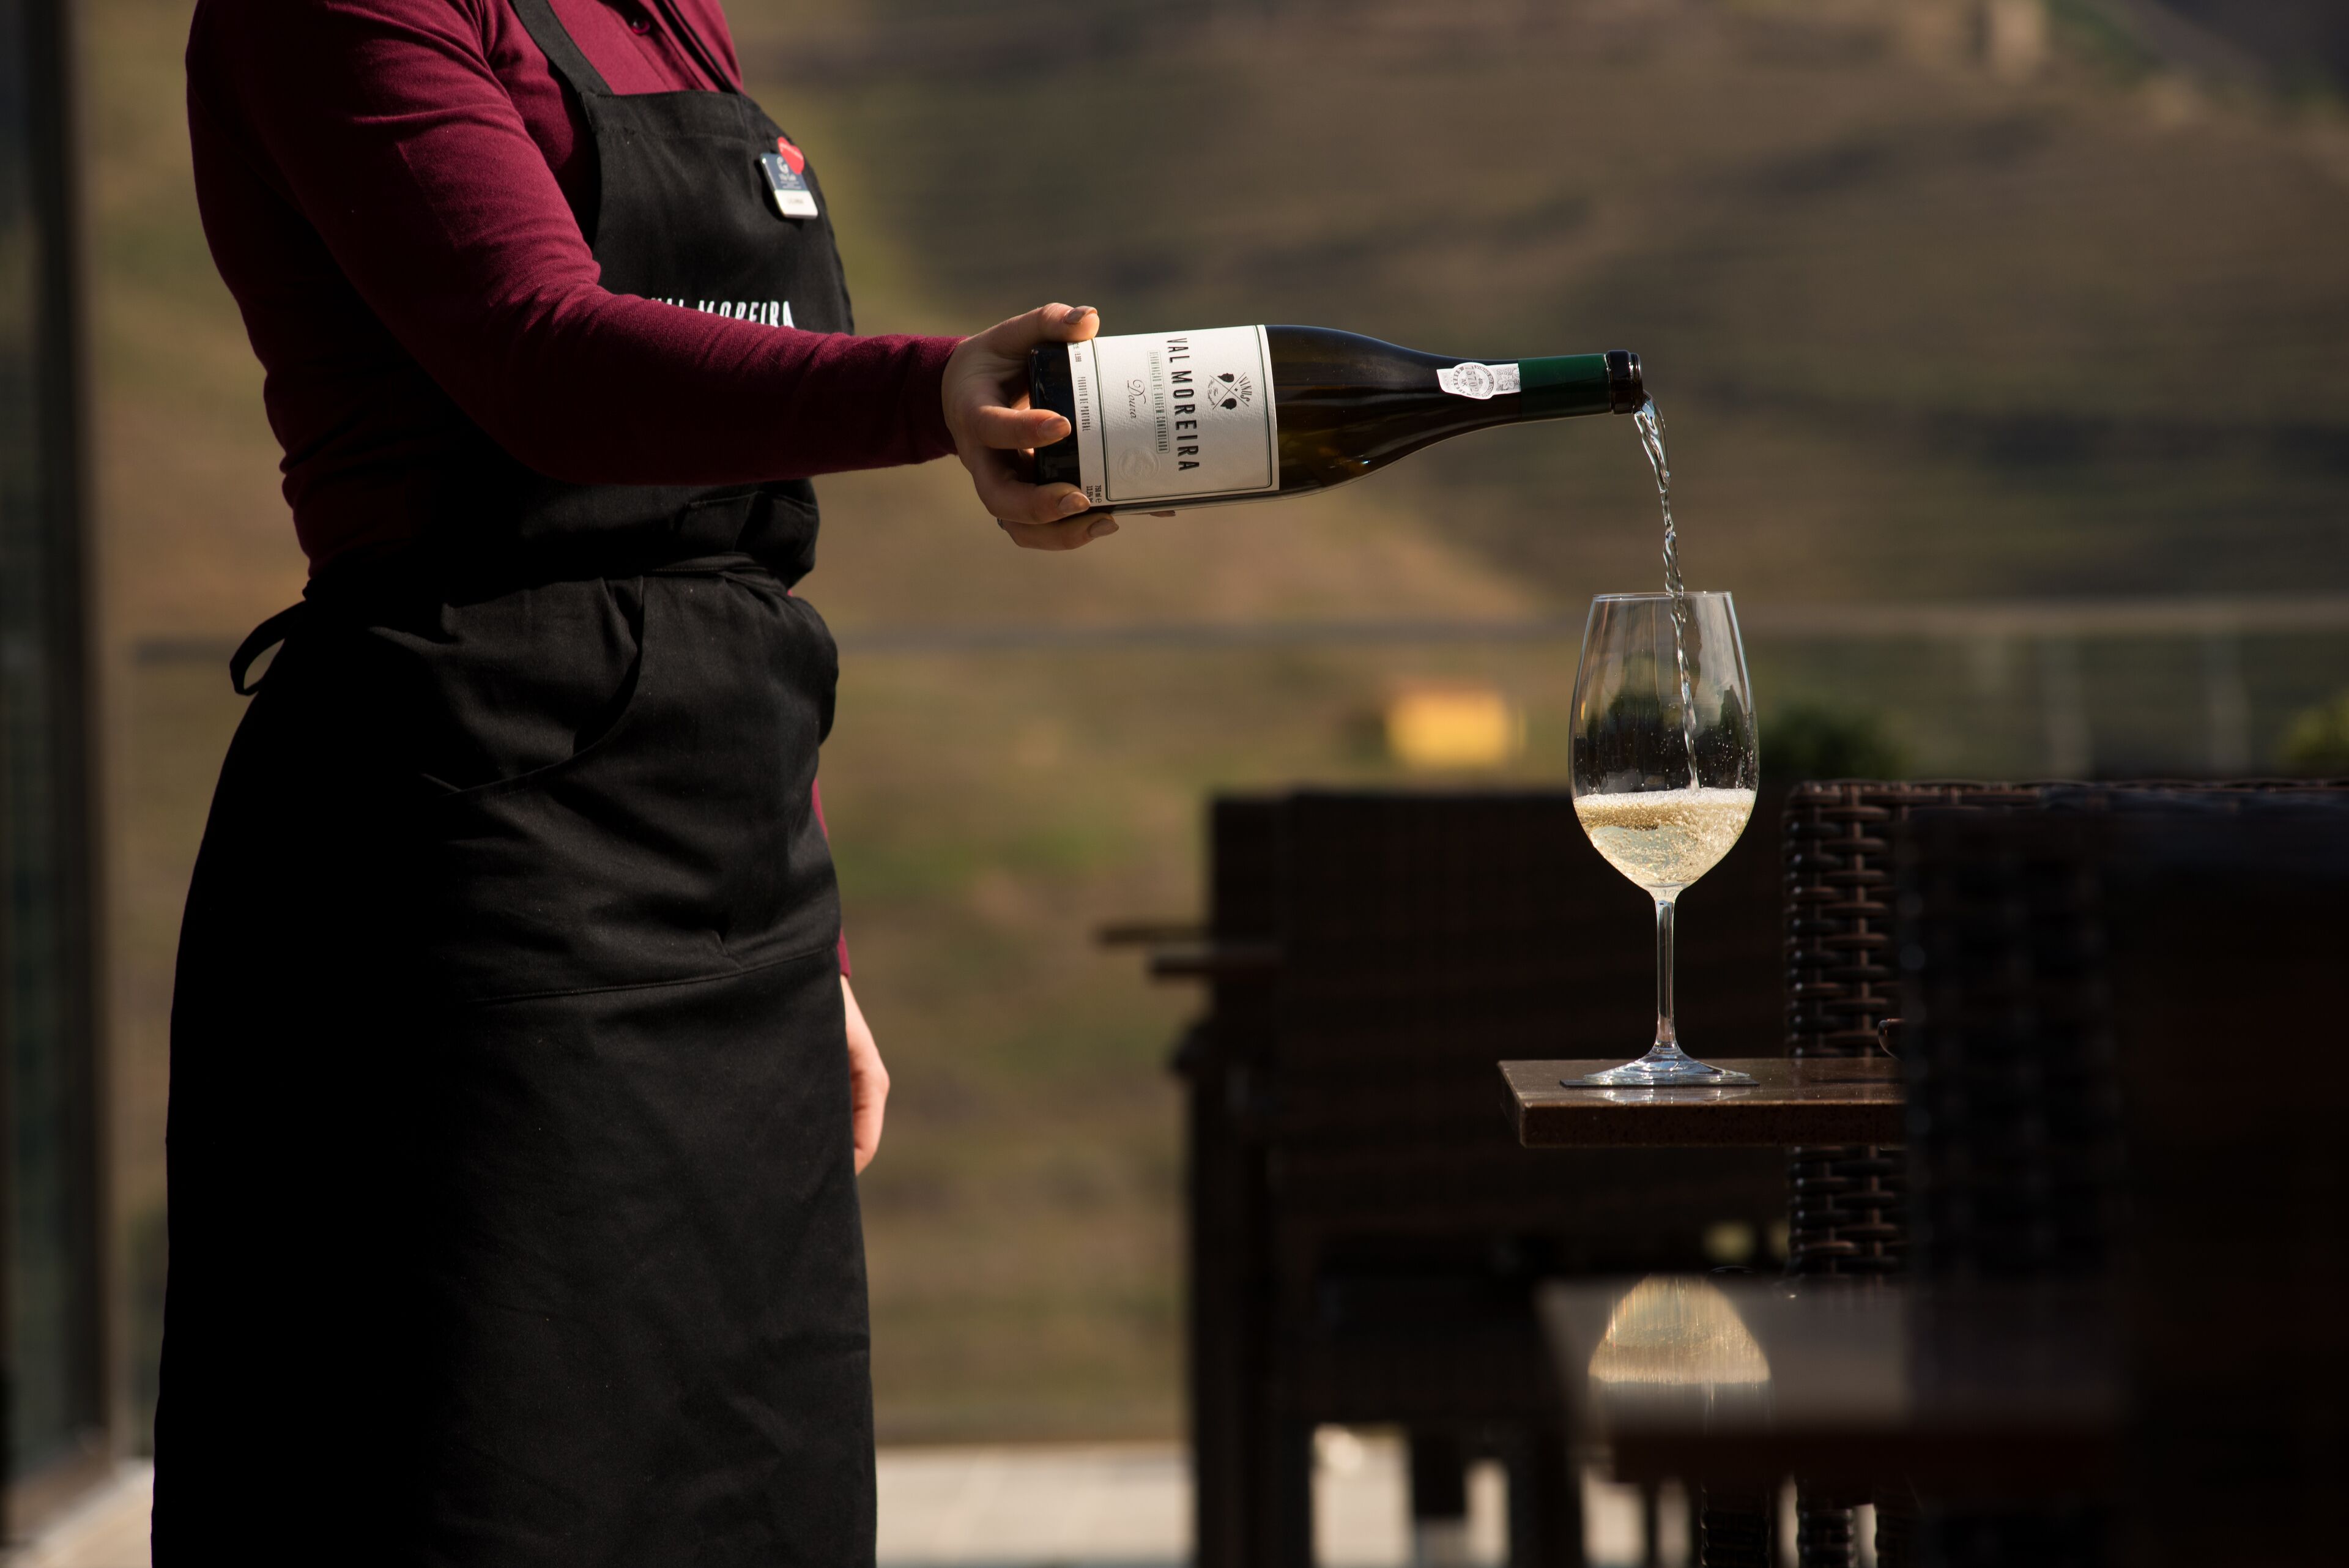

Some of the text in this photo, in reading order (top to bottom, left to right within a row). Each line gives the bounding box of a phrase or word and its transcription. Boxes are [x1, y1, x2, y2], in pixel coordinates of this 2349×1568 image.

[1077, 377, 1088, 396] PRODUTO
[1127, 379, 1146, 418] Douro
[1239, 376, 1252, 401] VINUS
[1154, 393, 1165, 413] ORIGEM
[1167, 338, 1200, 471] VAL MOREIRA
[1080, 406, 1091, 431] PORTUGAL
[1156, 416, 1168, 451] CONTROLADA
